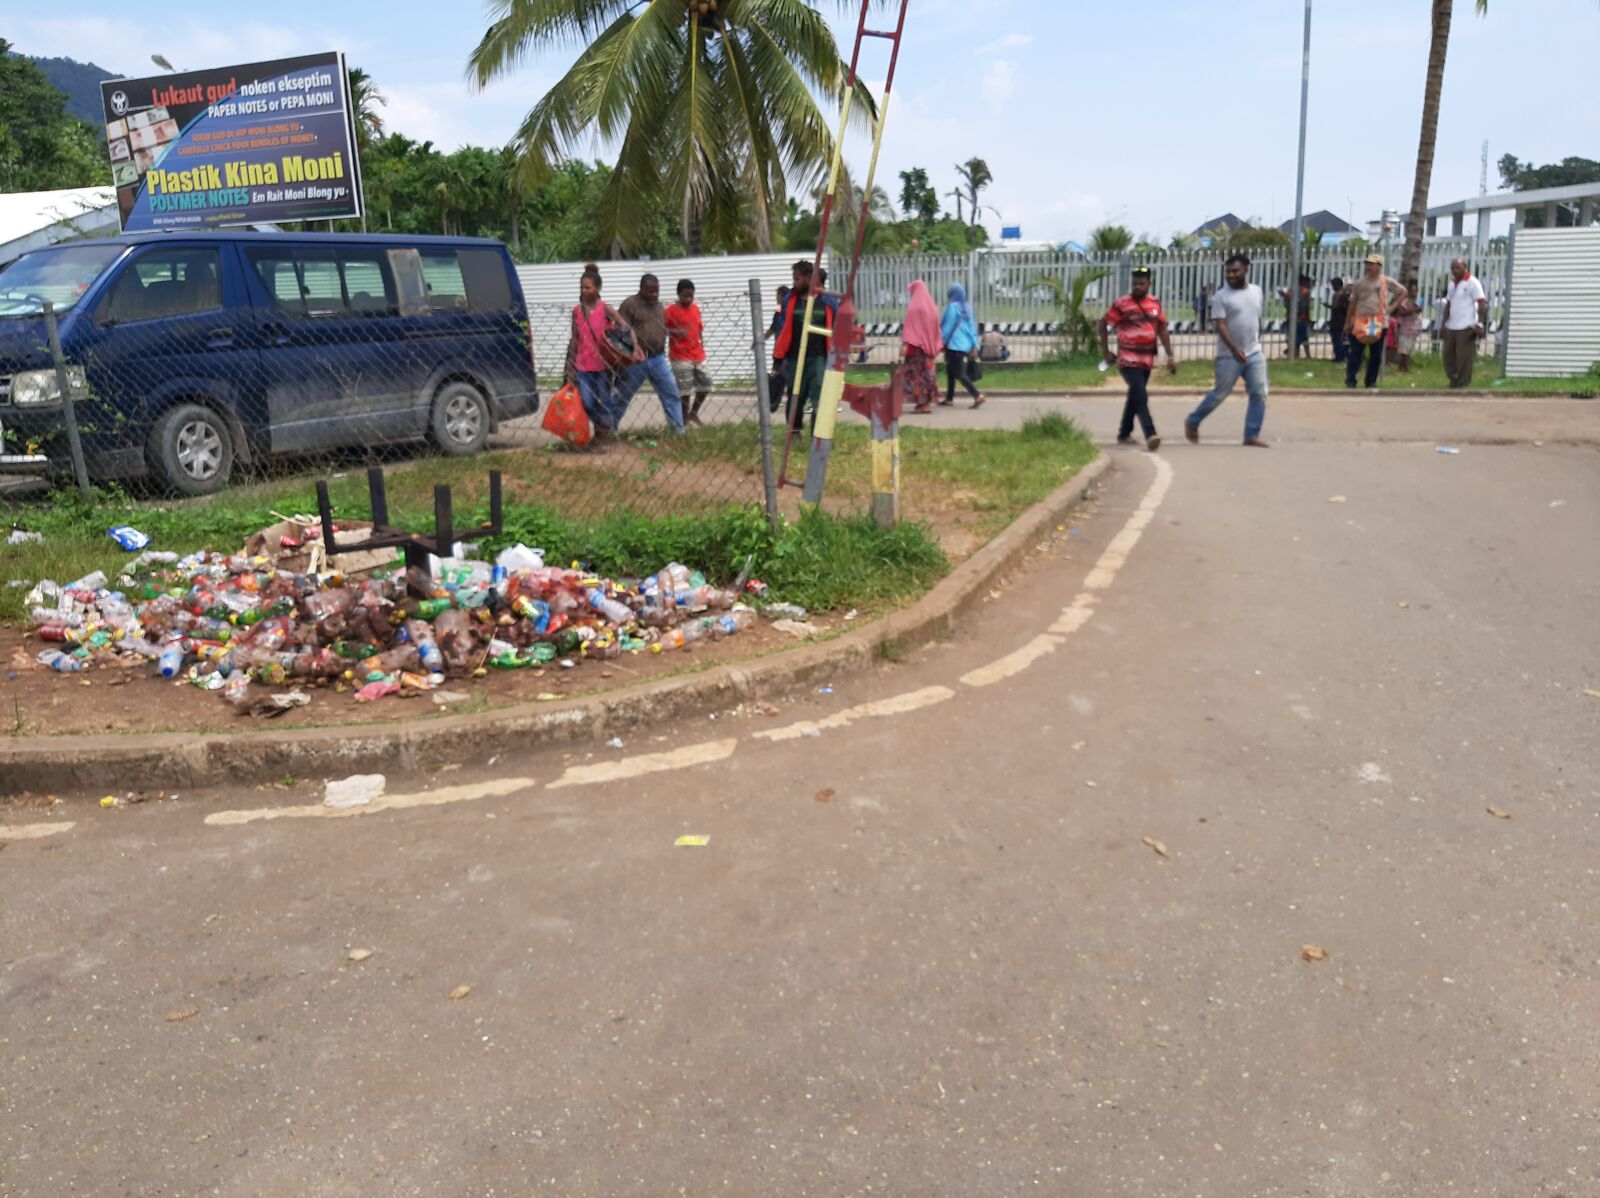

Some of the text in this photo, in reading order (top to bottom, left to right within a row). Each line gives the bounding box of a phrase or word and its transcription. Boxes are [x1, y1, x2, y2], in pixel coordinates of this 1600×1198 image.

[152, 78, 237, 107] Lukaut gud
[240, 73, 332, 97] noken ekseptim
[208, 92, 335, 119] PAPER NOTES or PEPA MONI
[146, 152, 344, 195] Plastik Kina Moni
[149, 188, 250, 213] POLYMER NOTES
[252, 192, 266, 204] Em
[266, 191, 284, 202] Rait
[284, 189, 307, 201] Moni
[307, 187, 333, 201] Blong
